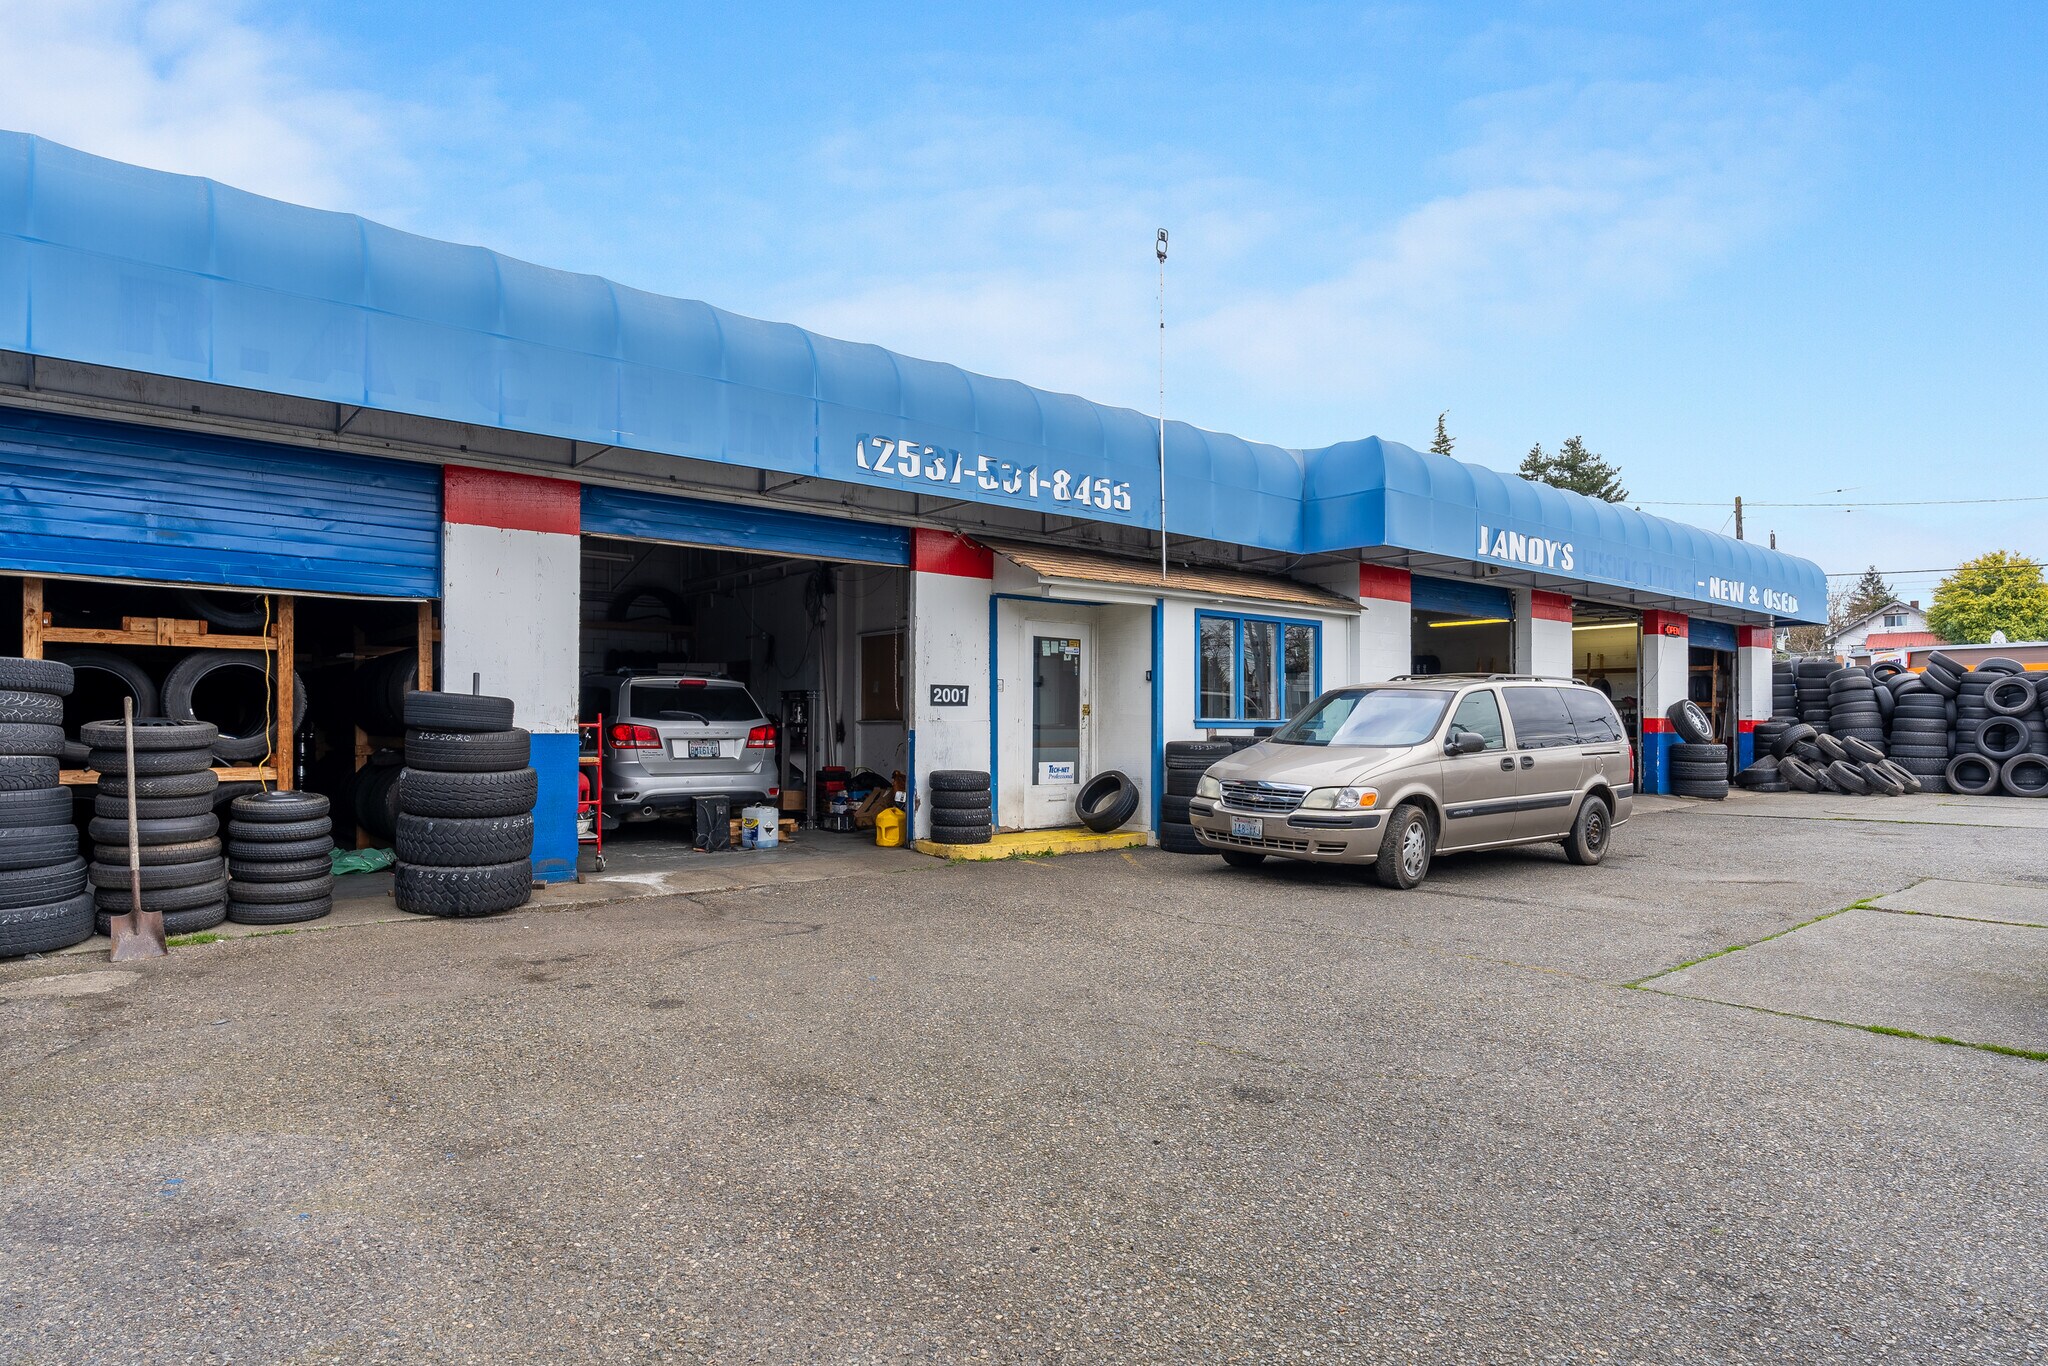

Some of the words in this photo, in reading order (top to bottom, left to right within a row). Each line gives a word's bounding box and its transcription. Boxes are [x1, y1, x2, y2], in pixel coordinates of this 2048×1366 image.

[1709, 576, 1745, 604] NEW
[1748, 585, 1760, 605] &
[1666, 625, 1680, 635] OPEN
[933, 687, 966, 703] 2001
